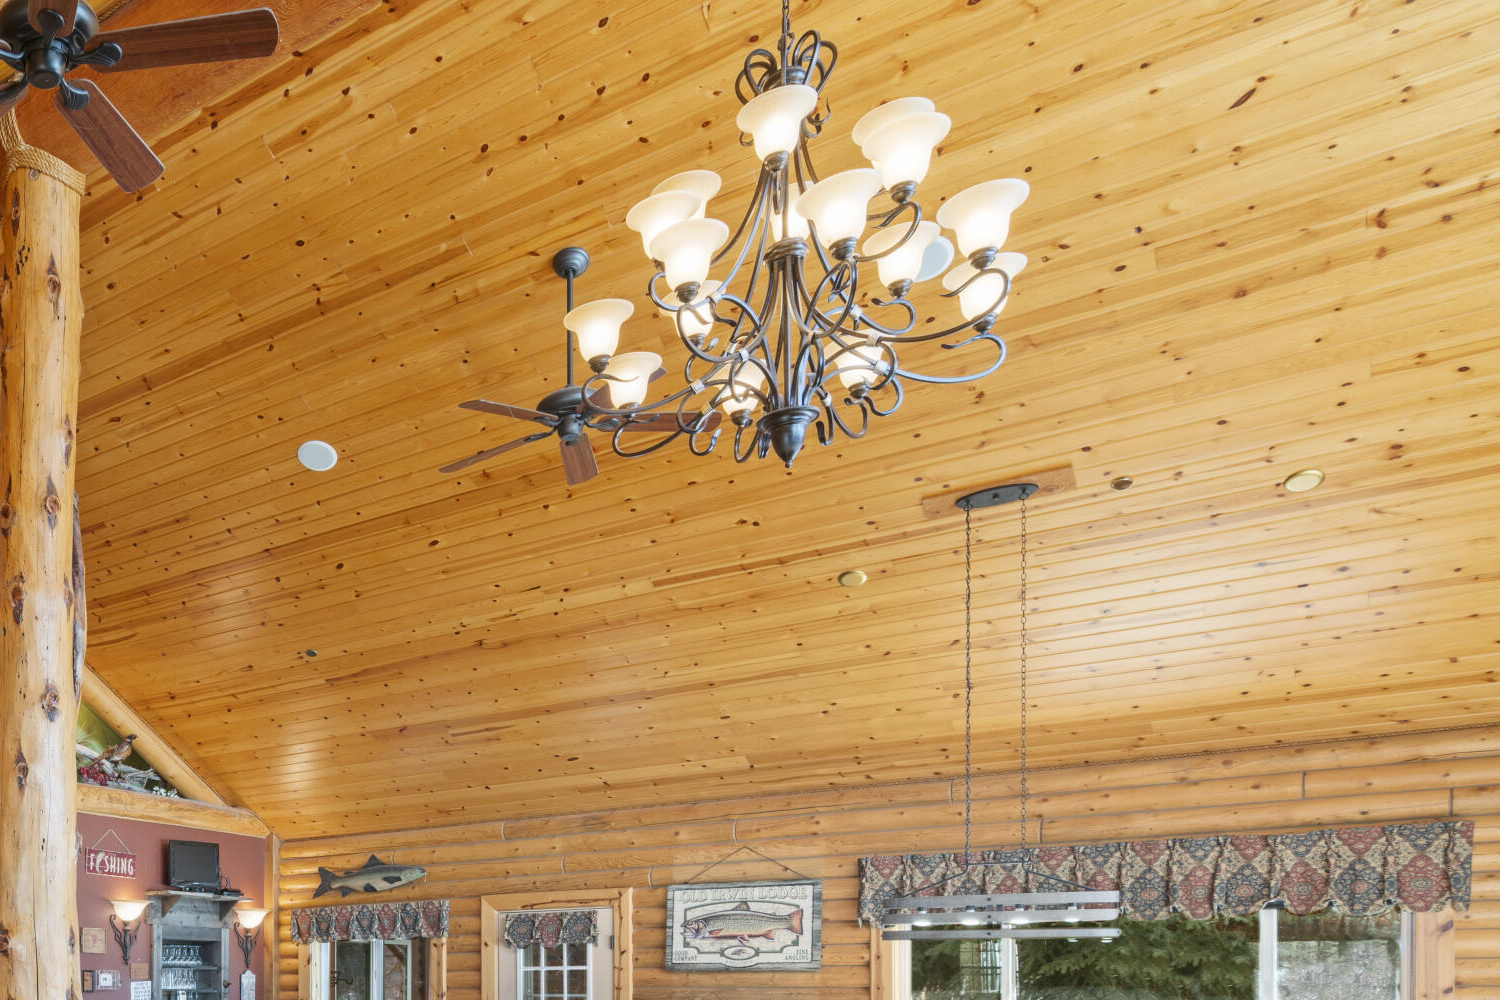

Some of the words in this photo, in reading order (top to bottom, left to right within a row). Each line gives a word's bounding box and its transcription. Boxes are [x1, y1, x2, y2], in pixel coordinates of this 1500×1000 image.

[682, 890, 708, 903] OLD
[711, 888, 754, 901] IRWIN
[757, 886, 808, 900] LODGE
